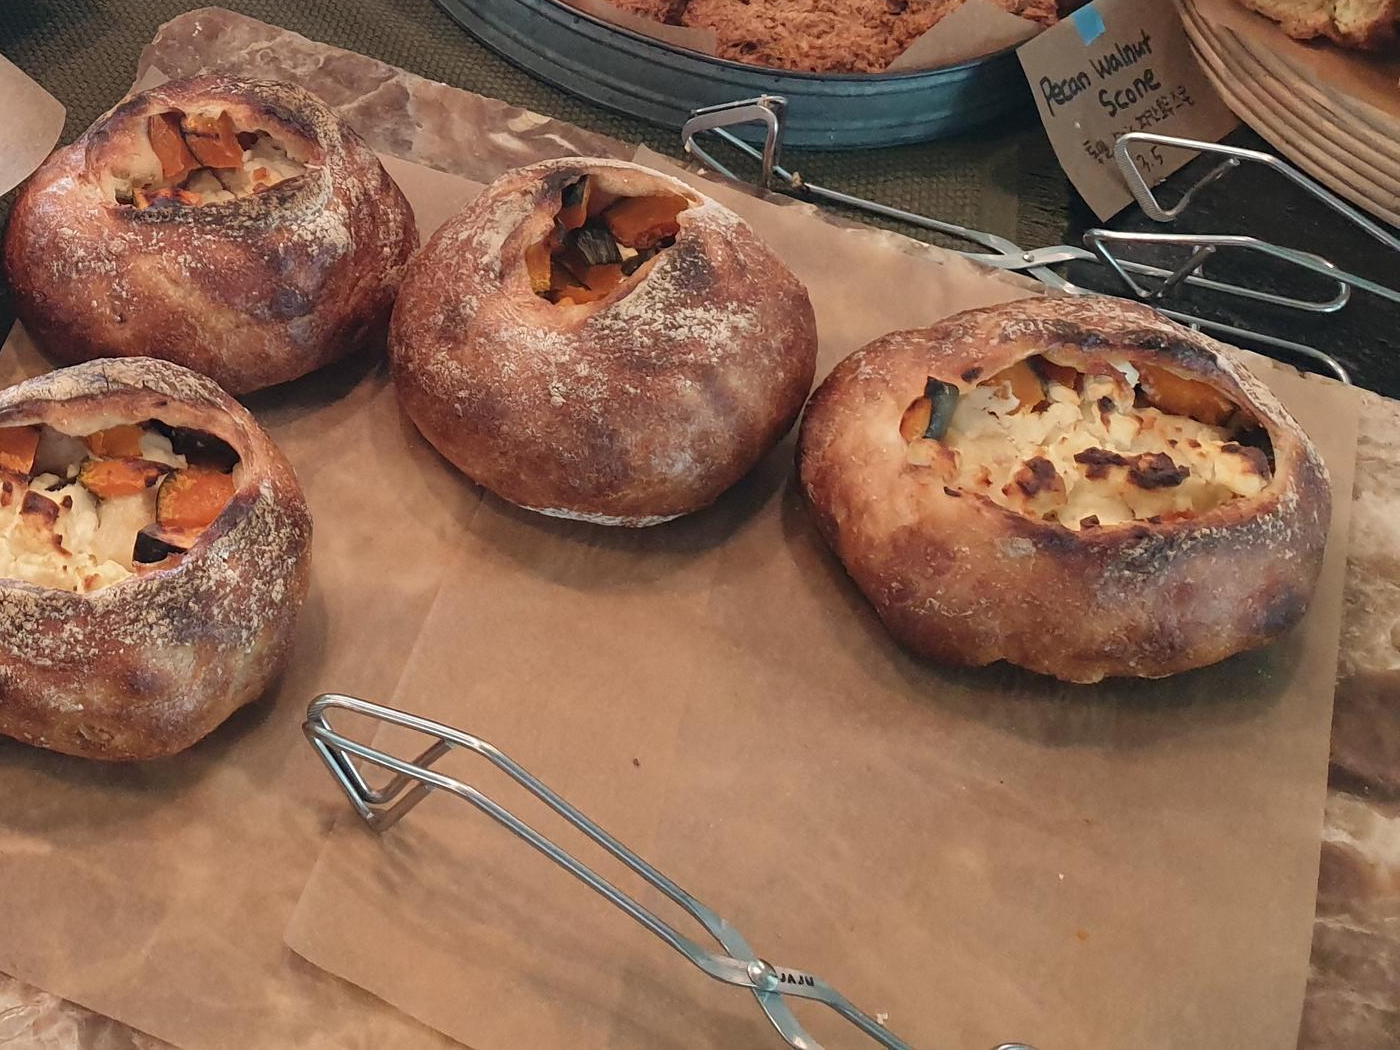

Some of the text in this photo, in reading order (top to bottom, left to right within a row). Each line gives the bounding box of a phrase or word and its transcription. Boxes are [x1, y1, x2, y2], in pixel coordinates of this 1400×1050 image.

[1039, 29, 1153, 117] Pecan Walnut
[1098, 68, 1162, 117] Scone
[779, 972, 815, 988] JAJU
